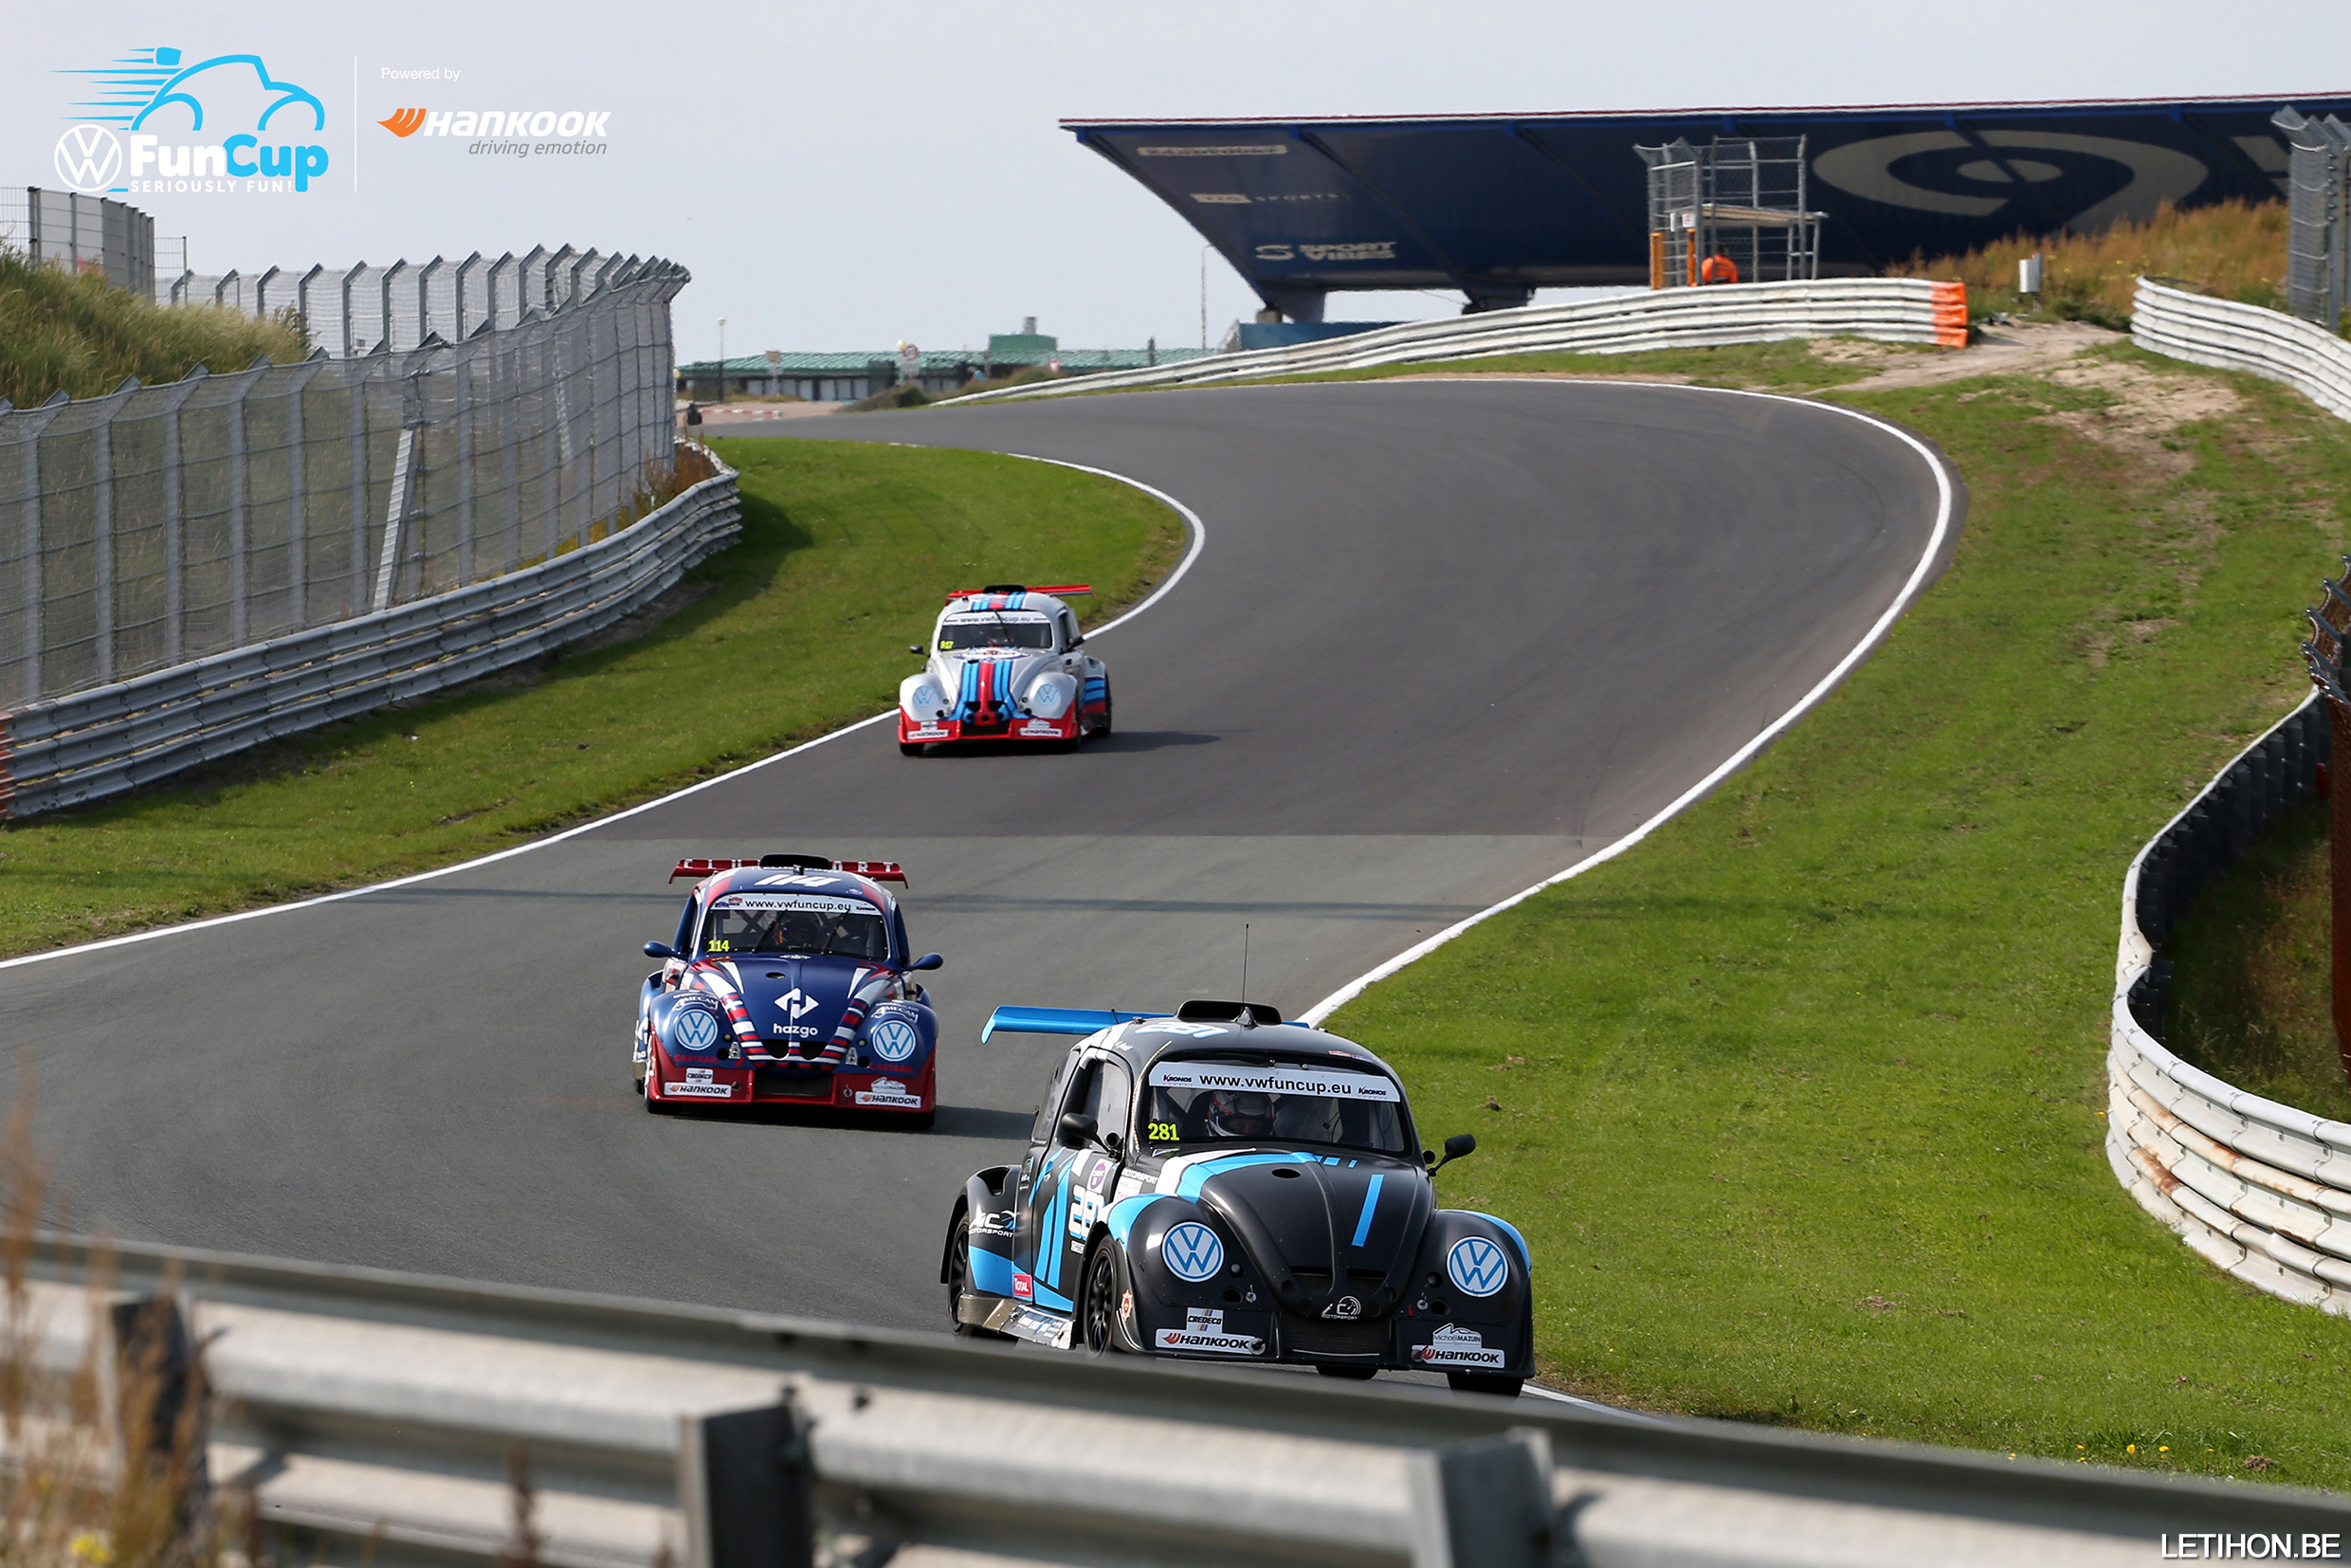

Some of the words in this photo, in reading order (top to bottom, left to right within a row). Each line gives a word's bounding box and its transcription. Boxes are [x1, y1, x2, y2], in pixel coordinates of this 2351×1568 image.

[754, 873, 843, 887] 114
[745, 899, 851, 911] www.vwfuncup.eu
[708, 939, 730, 953] 114
[773, 1022, 818, 1039] hazgo
[1199, 1073, 1352, 1095] www.vwfuncup.eu
[1147, 1122, 1180, 1141] 281
[1187, 1315, 1222, 1325] CREDECO
